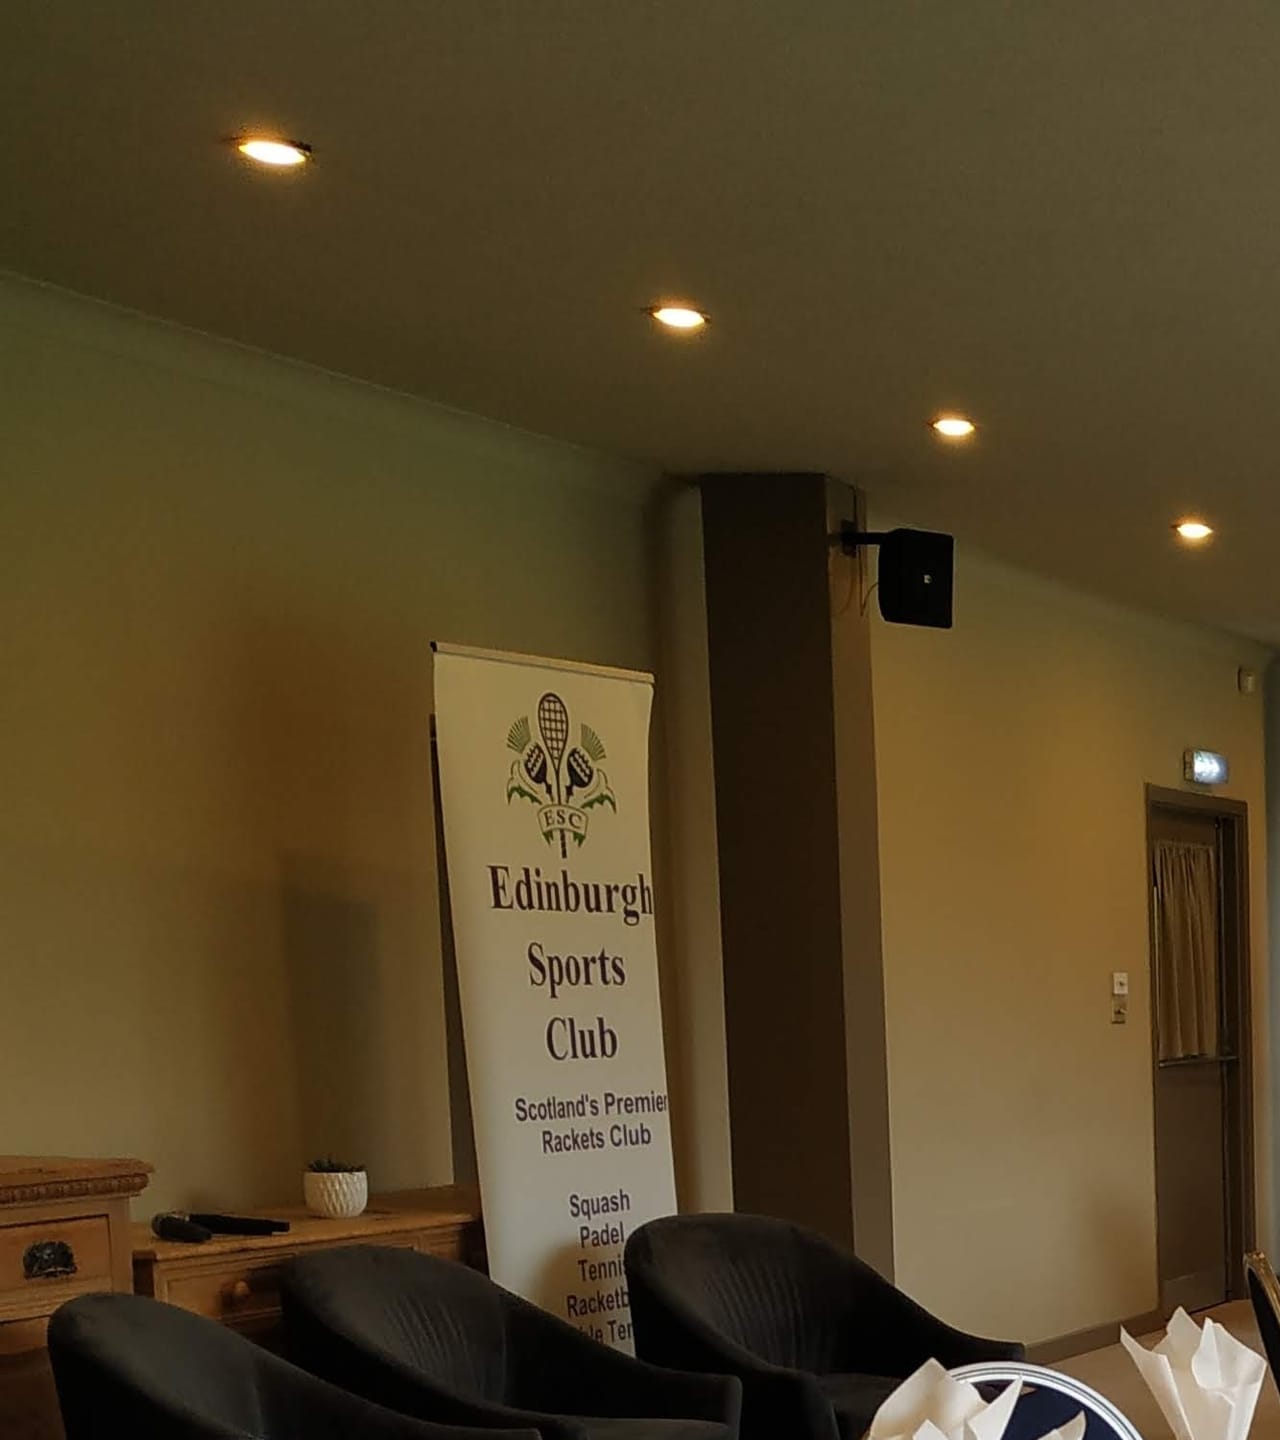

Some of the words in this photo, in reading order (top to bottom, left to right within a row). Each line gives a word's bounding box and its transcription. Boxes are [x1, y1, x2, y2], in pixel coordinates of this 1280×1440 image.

[544, 809, 583, 830] ESC
[486, 864, 653, 926] Edinburgh
[527, 942, 626, 999] Sports
[546, 1016, 618, 1060] Club
[515, 1094, 600, 1122] Scotland's
[604, 1090, 667, 1115] Premier
[542, 1126, 605, 1154] Rackets
[610, 1123, 651, 1148] Club
[569, 1189, 630, 1220] Squash
[580, 1221, 624, 1248] Padel
[567, 1286, 630, 1318] Racketb
